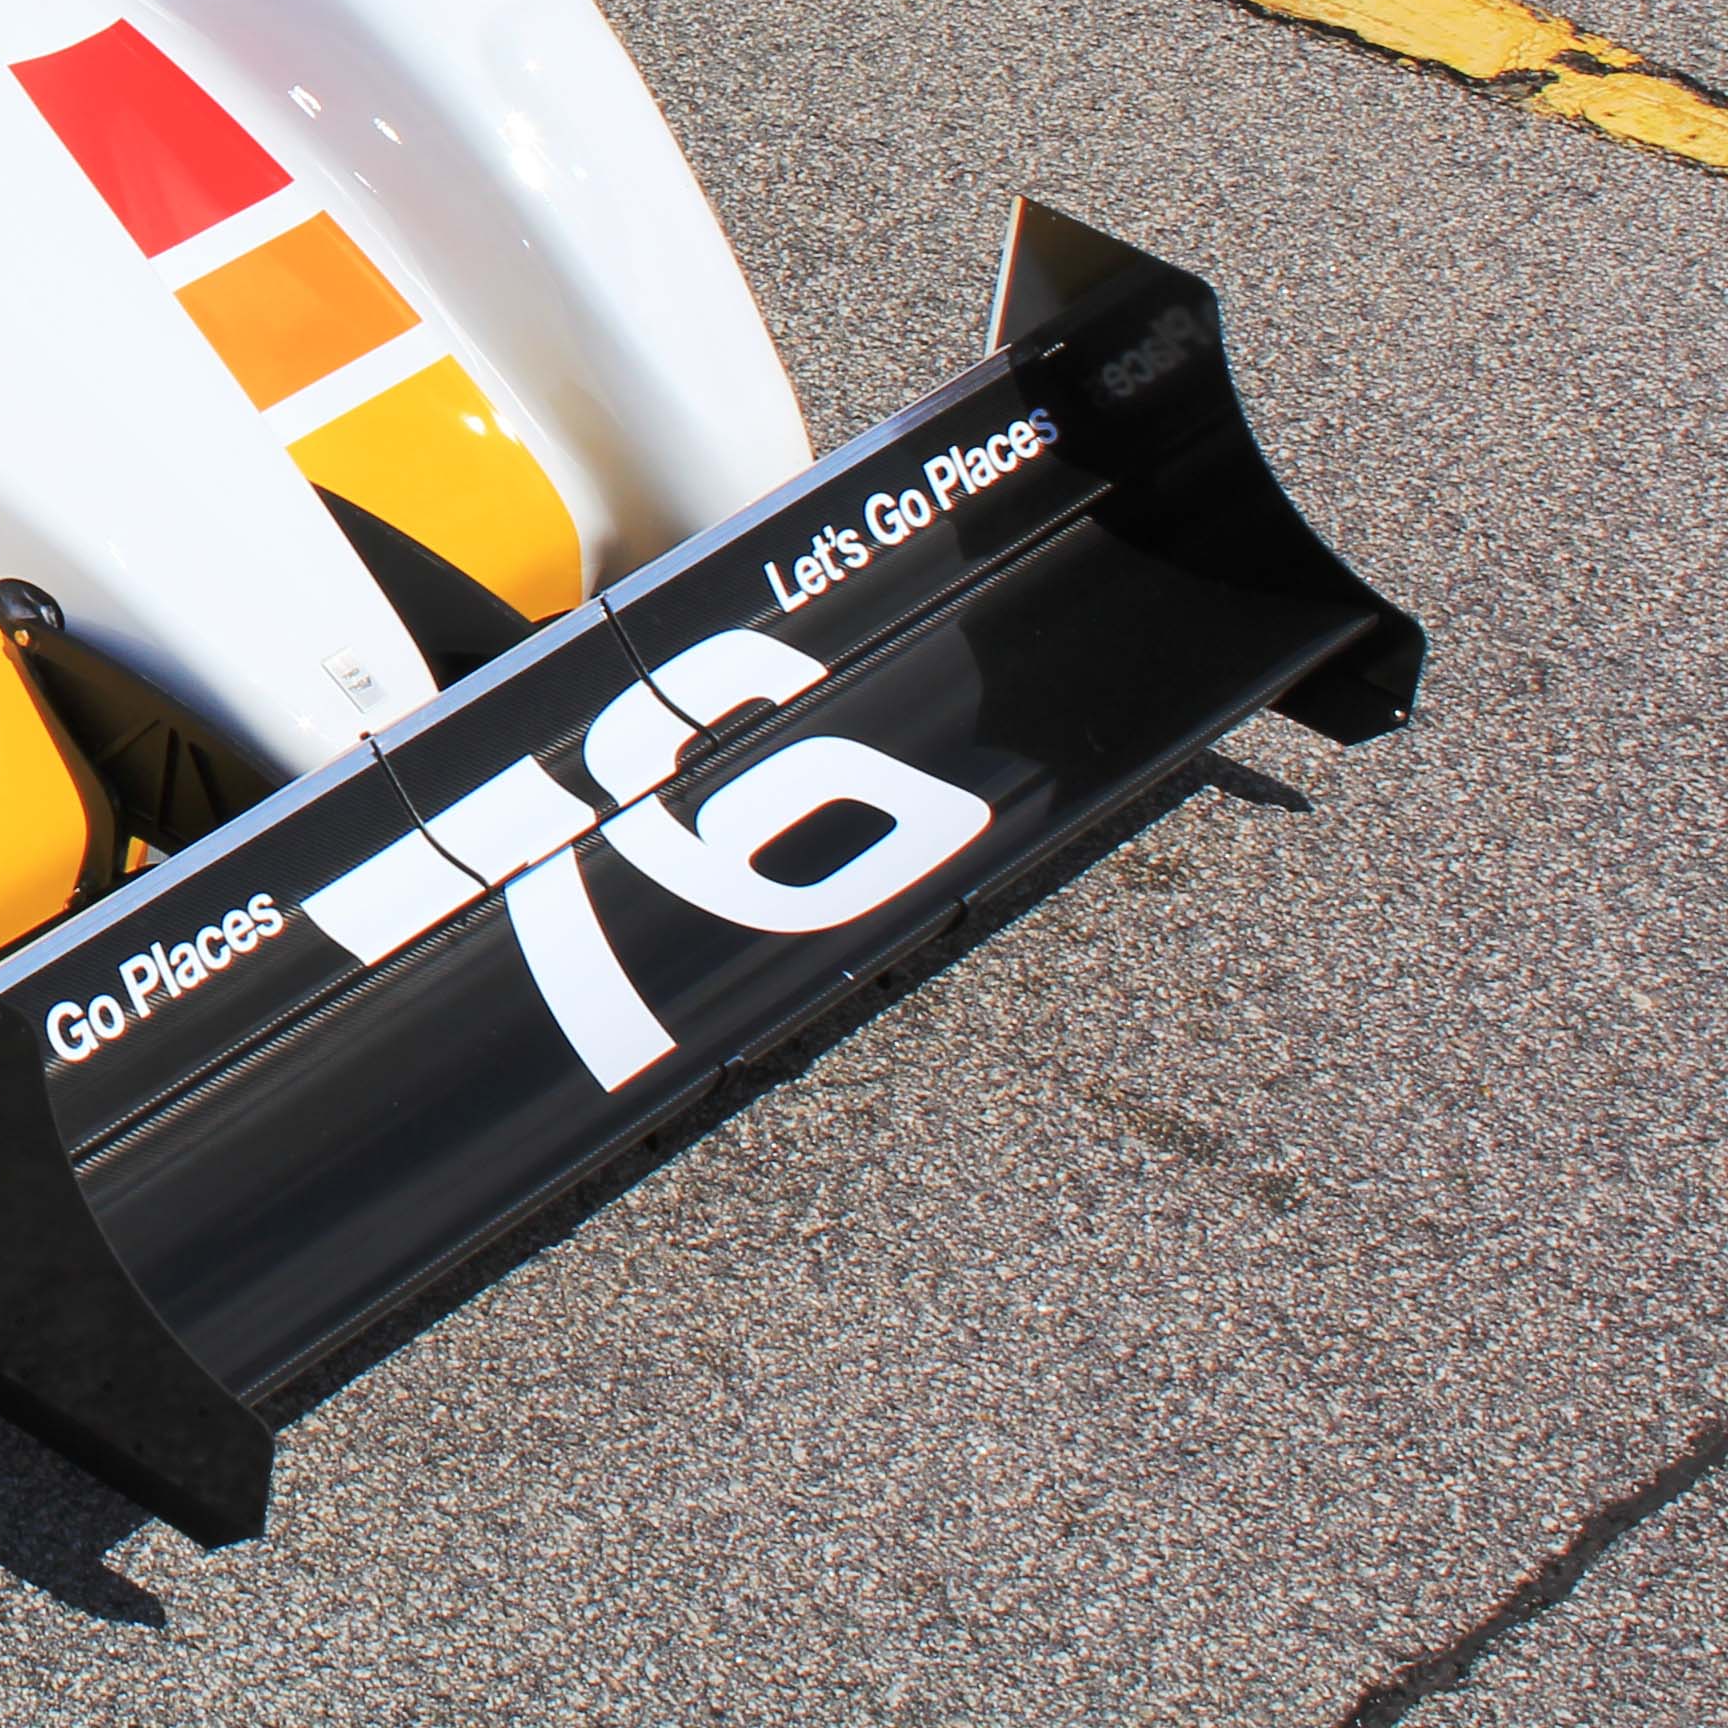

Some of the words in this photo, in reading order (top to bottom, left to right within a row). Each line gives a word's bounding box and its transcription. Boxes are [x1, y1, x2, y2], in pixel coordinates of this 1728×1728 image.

[763, 524, 870, 613] Let's
[863, 488, 932, 546] Go
[922, 408, 1059, 512] Places
[300, 628, 992, 1093] 76
[45, 1000, 126, 1063] Go
[118, 892, 284, 1019] Places
